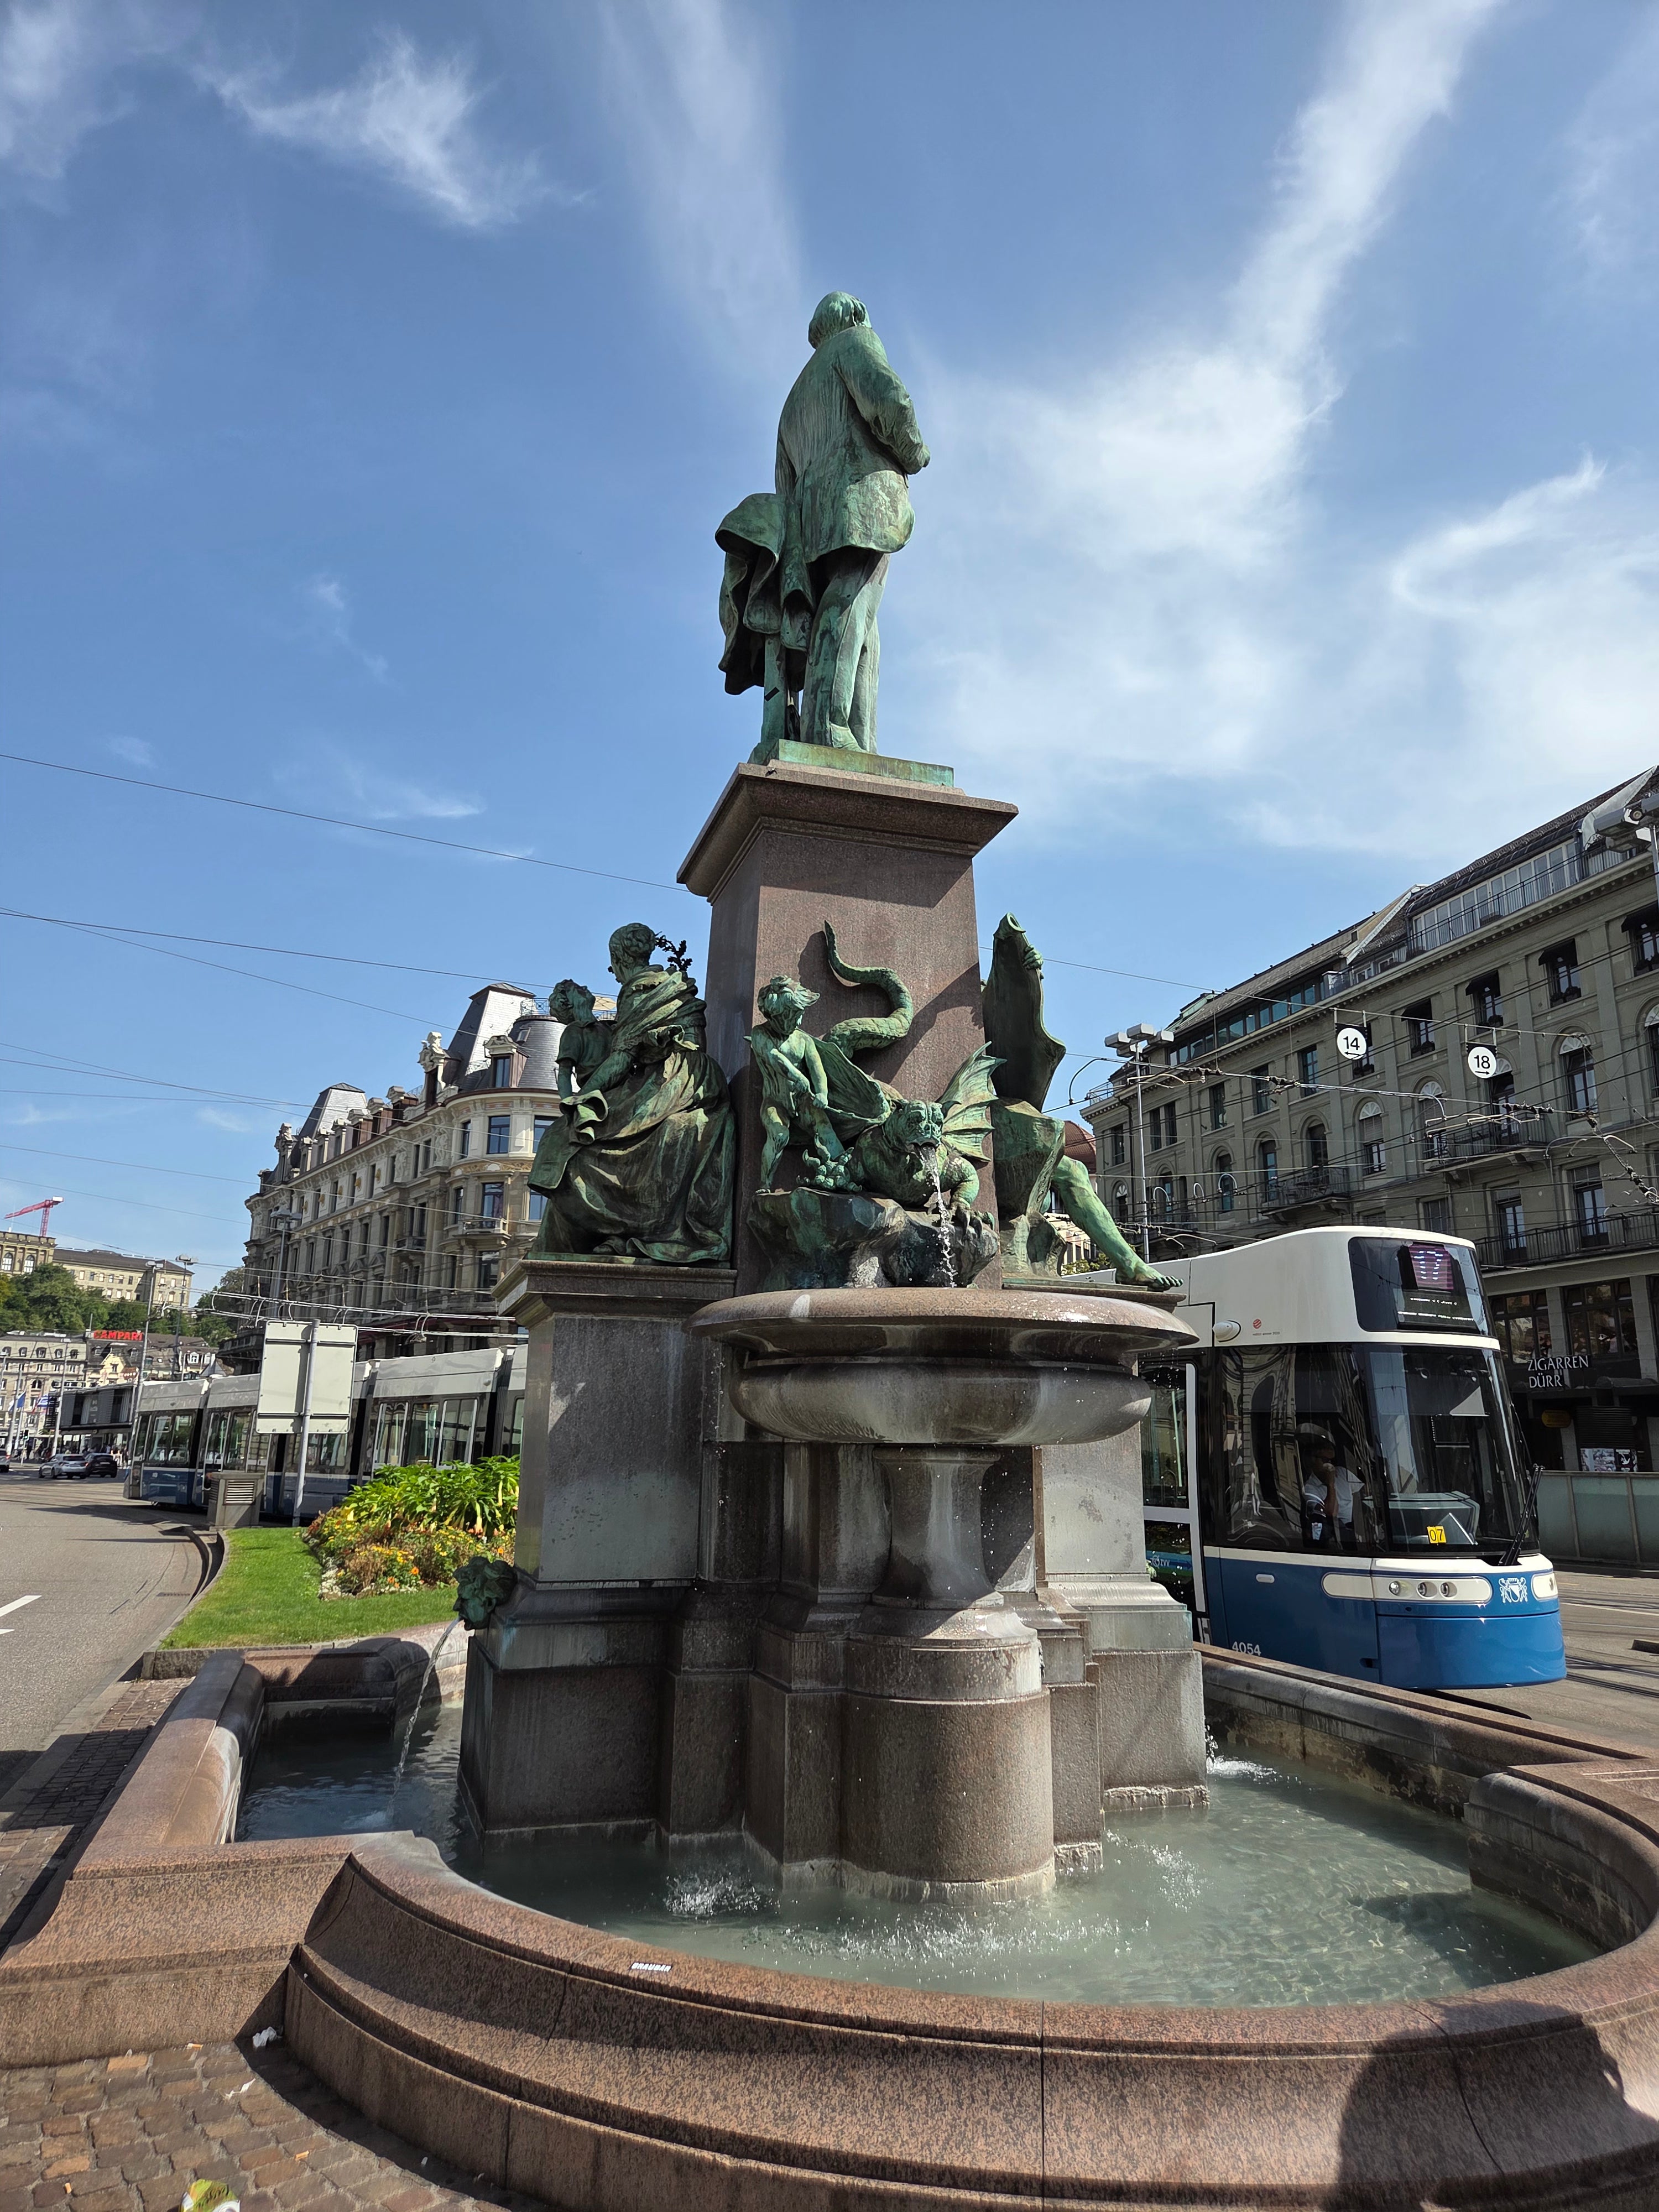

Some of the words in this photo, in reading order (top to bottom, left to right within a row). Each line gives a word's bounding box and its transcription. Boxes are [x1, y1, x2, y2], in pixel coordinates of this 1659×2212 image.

[1343, 1036, 1360, 1051] 14
[1473, 1055, 1490, 1069] 18
[93, 1329, 143, 1341] CAMPARI
[1527, 1355, 1589, 1371] ZIGARREN
[1528, 1373, 1563, 1389] DÜRR
[1430, 1528, 1443, 1541] 07
[1232, 1641, 1261, 1656] 4054
